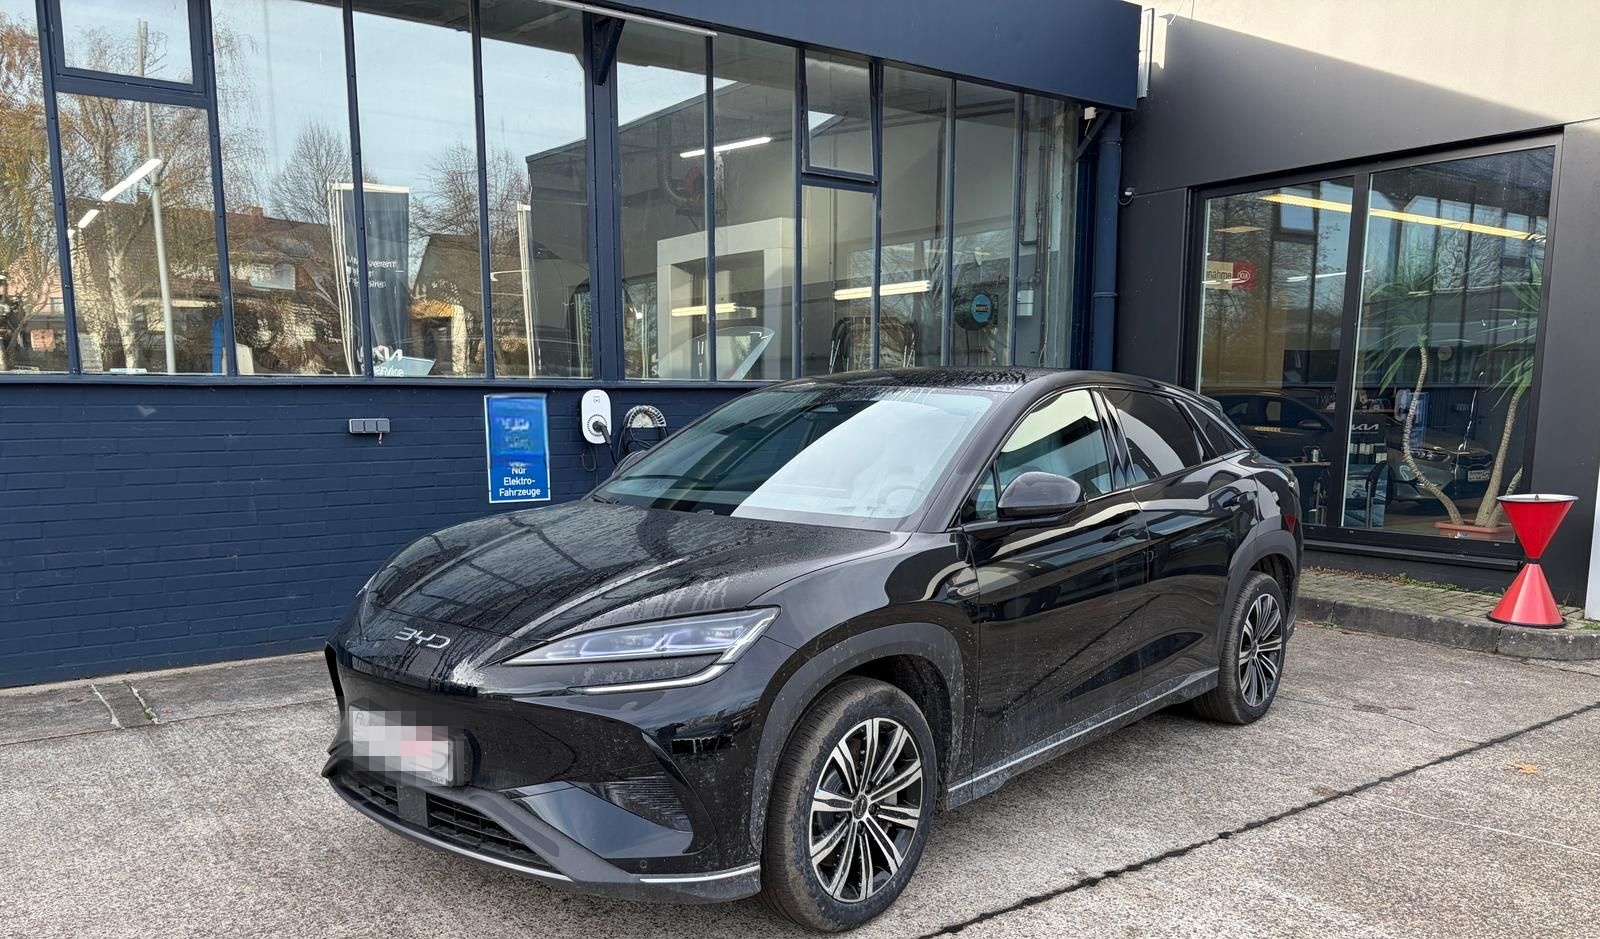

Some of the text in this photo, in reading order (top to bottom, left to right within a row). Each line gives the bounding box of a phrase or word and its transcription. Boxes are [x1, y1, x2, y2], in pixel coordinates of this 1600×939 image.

[503, 477, 536, 486] Elektro-
[499, 488, 541, 498] Fahrzeuge
[394, 627, 451, 649] BYD
